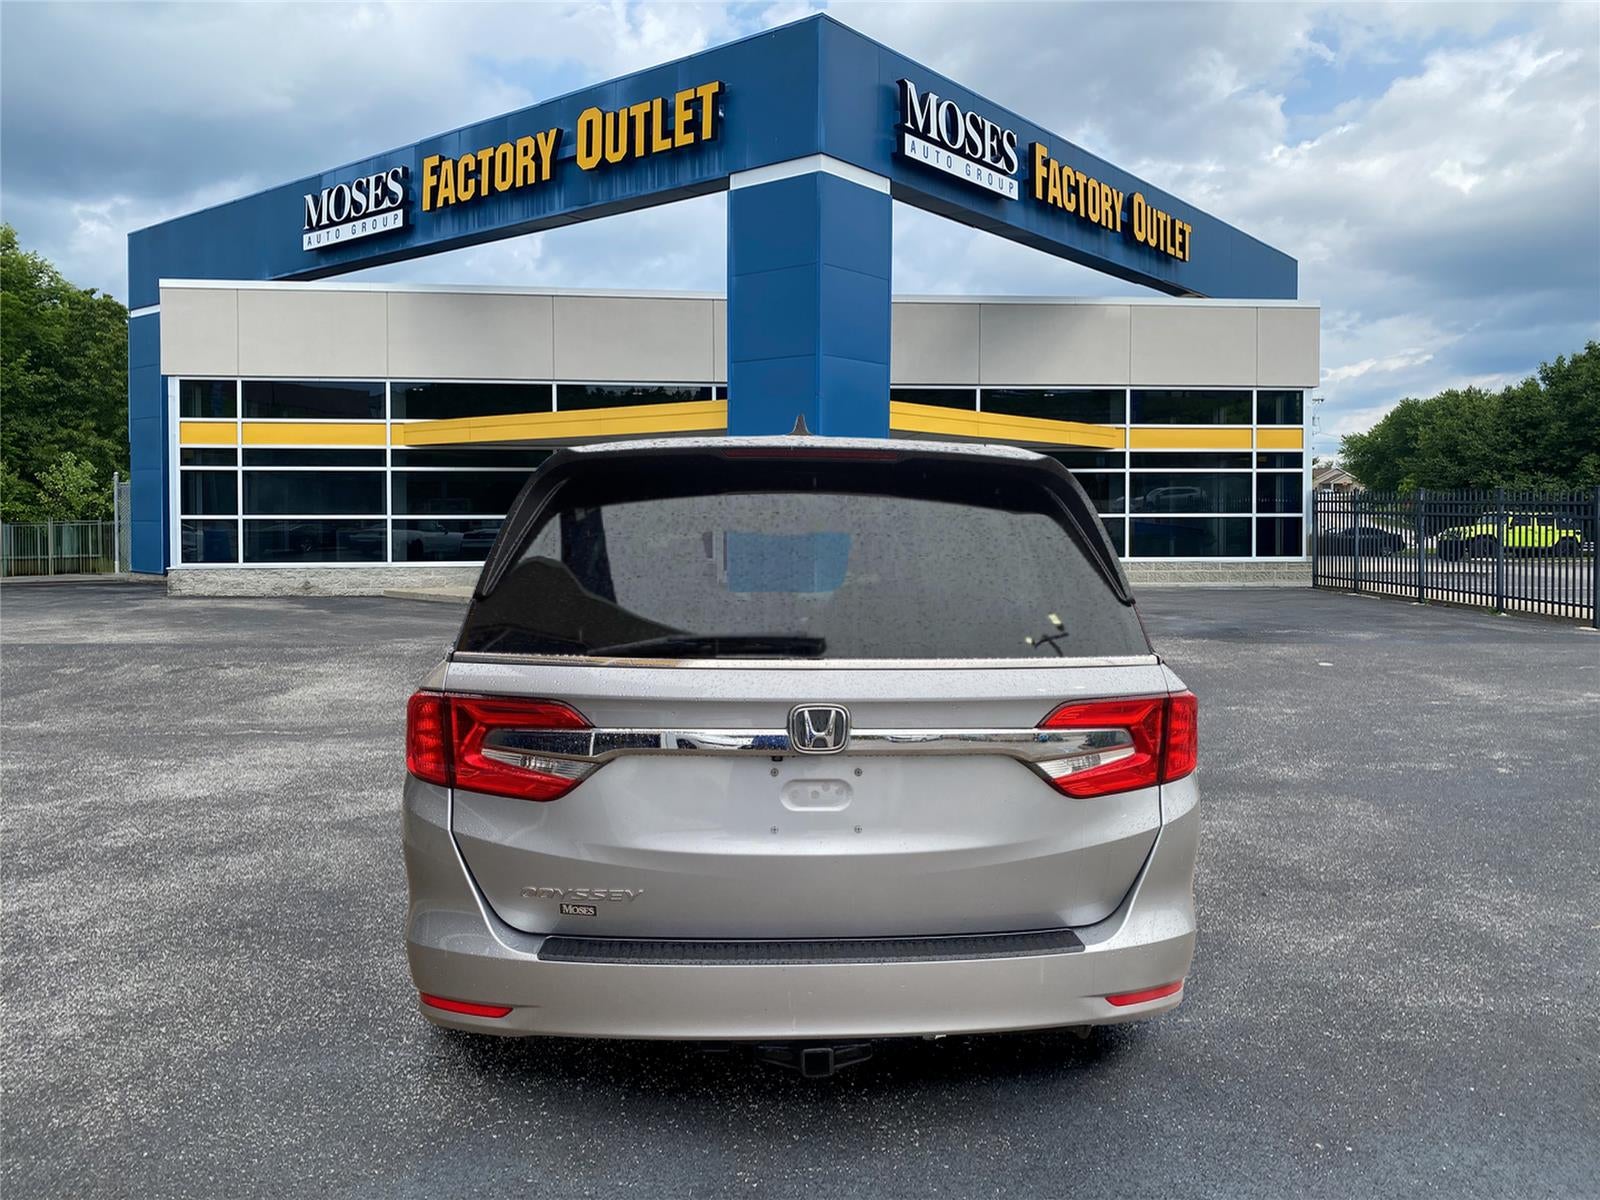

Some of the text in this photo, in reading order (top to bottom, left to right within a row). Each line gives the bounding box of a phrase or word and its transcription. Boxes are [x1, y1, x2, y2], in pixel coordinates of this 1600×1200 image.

[422, 80, 721, 211] FACTORY OUTLET
[903, 78, 1019, 175] MOSES
[909, 138, 1015, 194] AUTO GROUP
[303, 167, 404, 230] MOSES
[1034, 142, 1192, 262] FACTORY OUTLET
[307, 212, 399, 247] AUTO GROUP
[520, 886, 644, 902] ODYSSEY
[562, 904, 595, 915] MOSES
